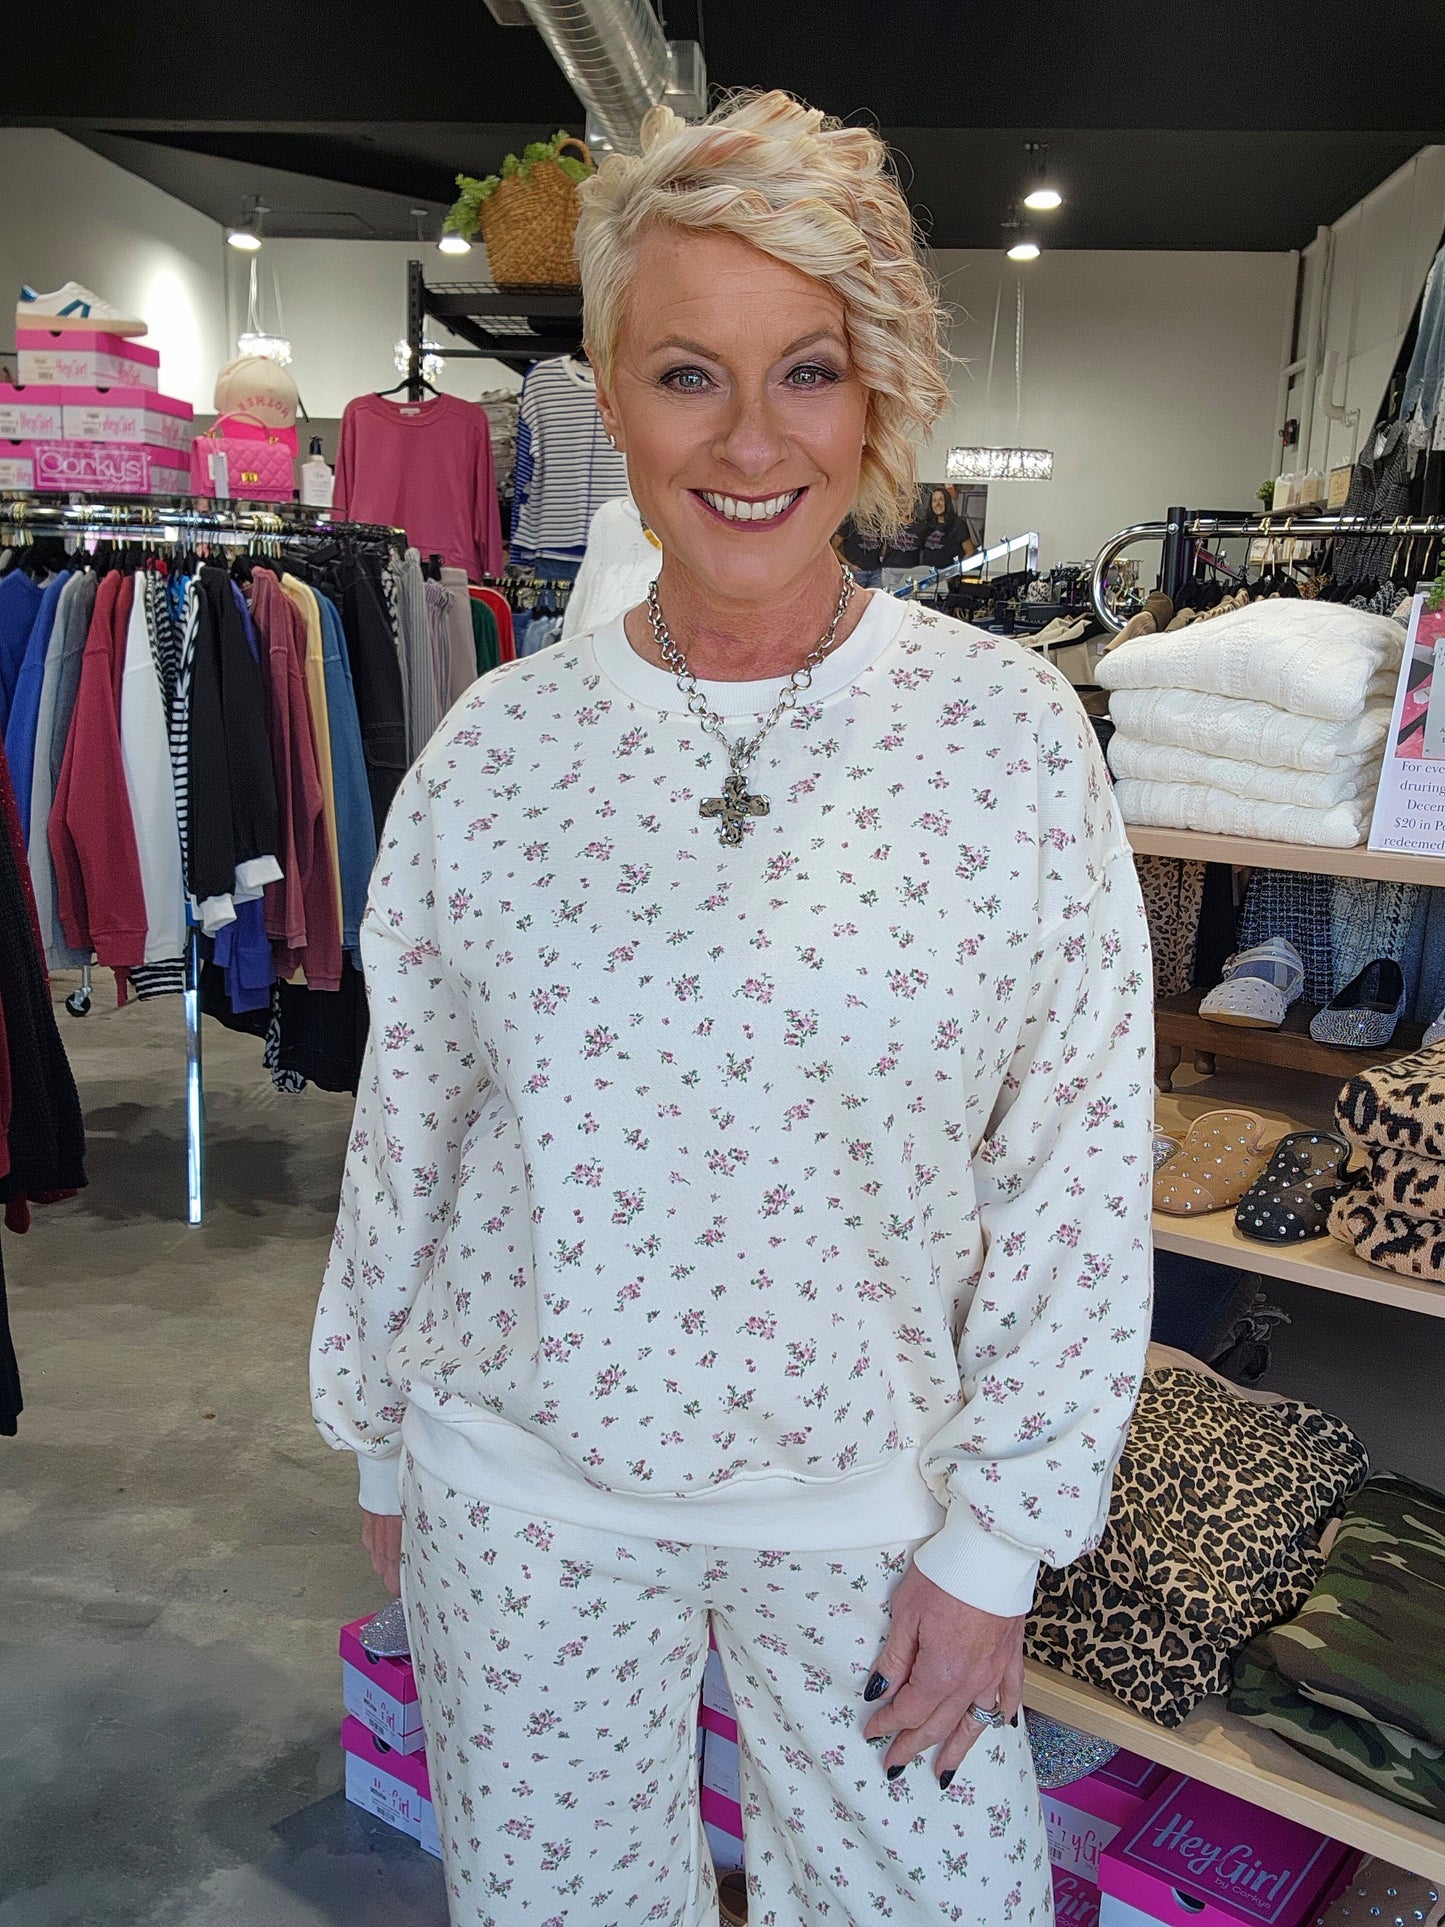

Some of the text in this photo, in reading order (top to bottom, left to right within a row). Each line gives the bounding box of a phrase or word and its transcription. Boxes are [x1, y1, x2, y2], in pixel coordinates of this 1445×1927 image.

[1401, 760, 1423, 773] For
[1394, 816, 1416, 829] $20
[1420, 819, 1431, 831] in
[1384, 836, 1445, 851] redeemed
[1152, 1812, 1291, 1902] HeyGirl
